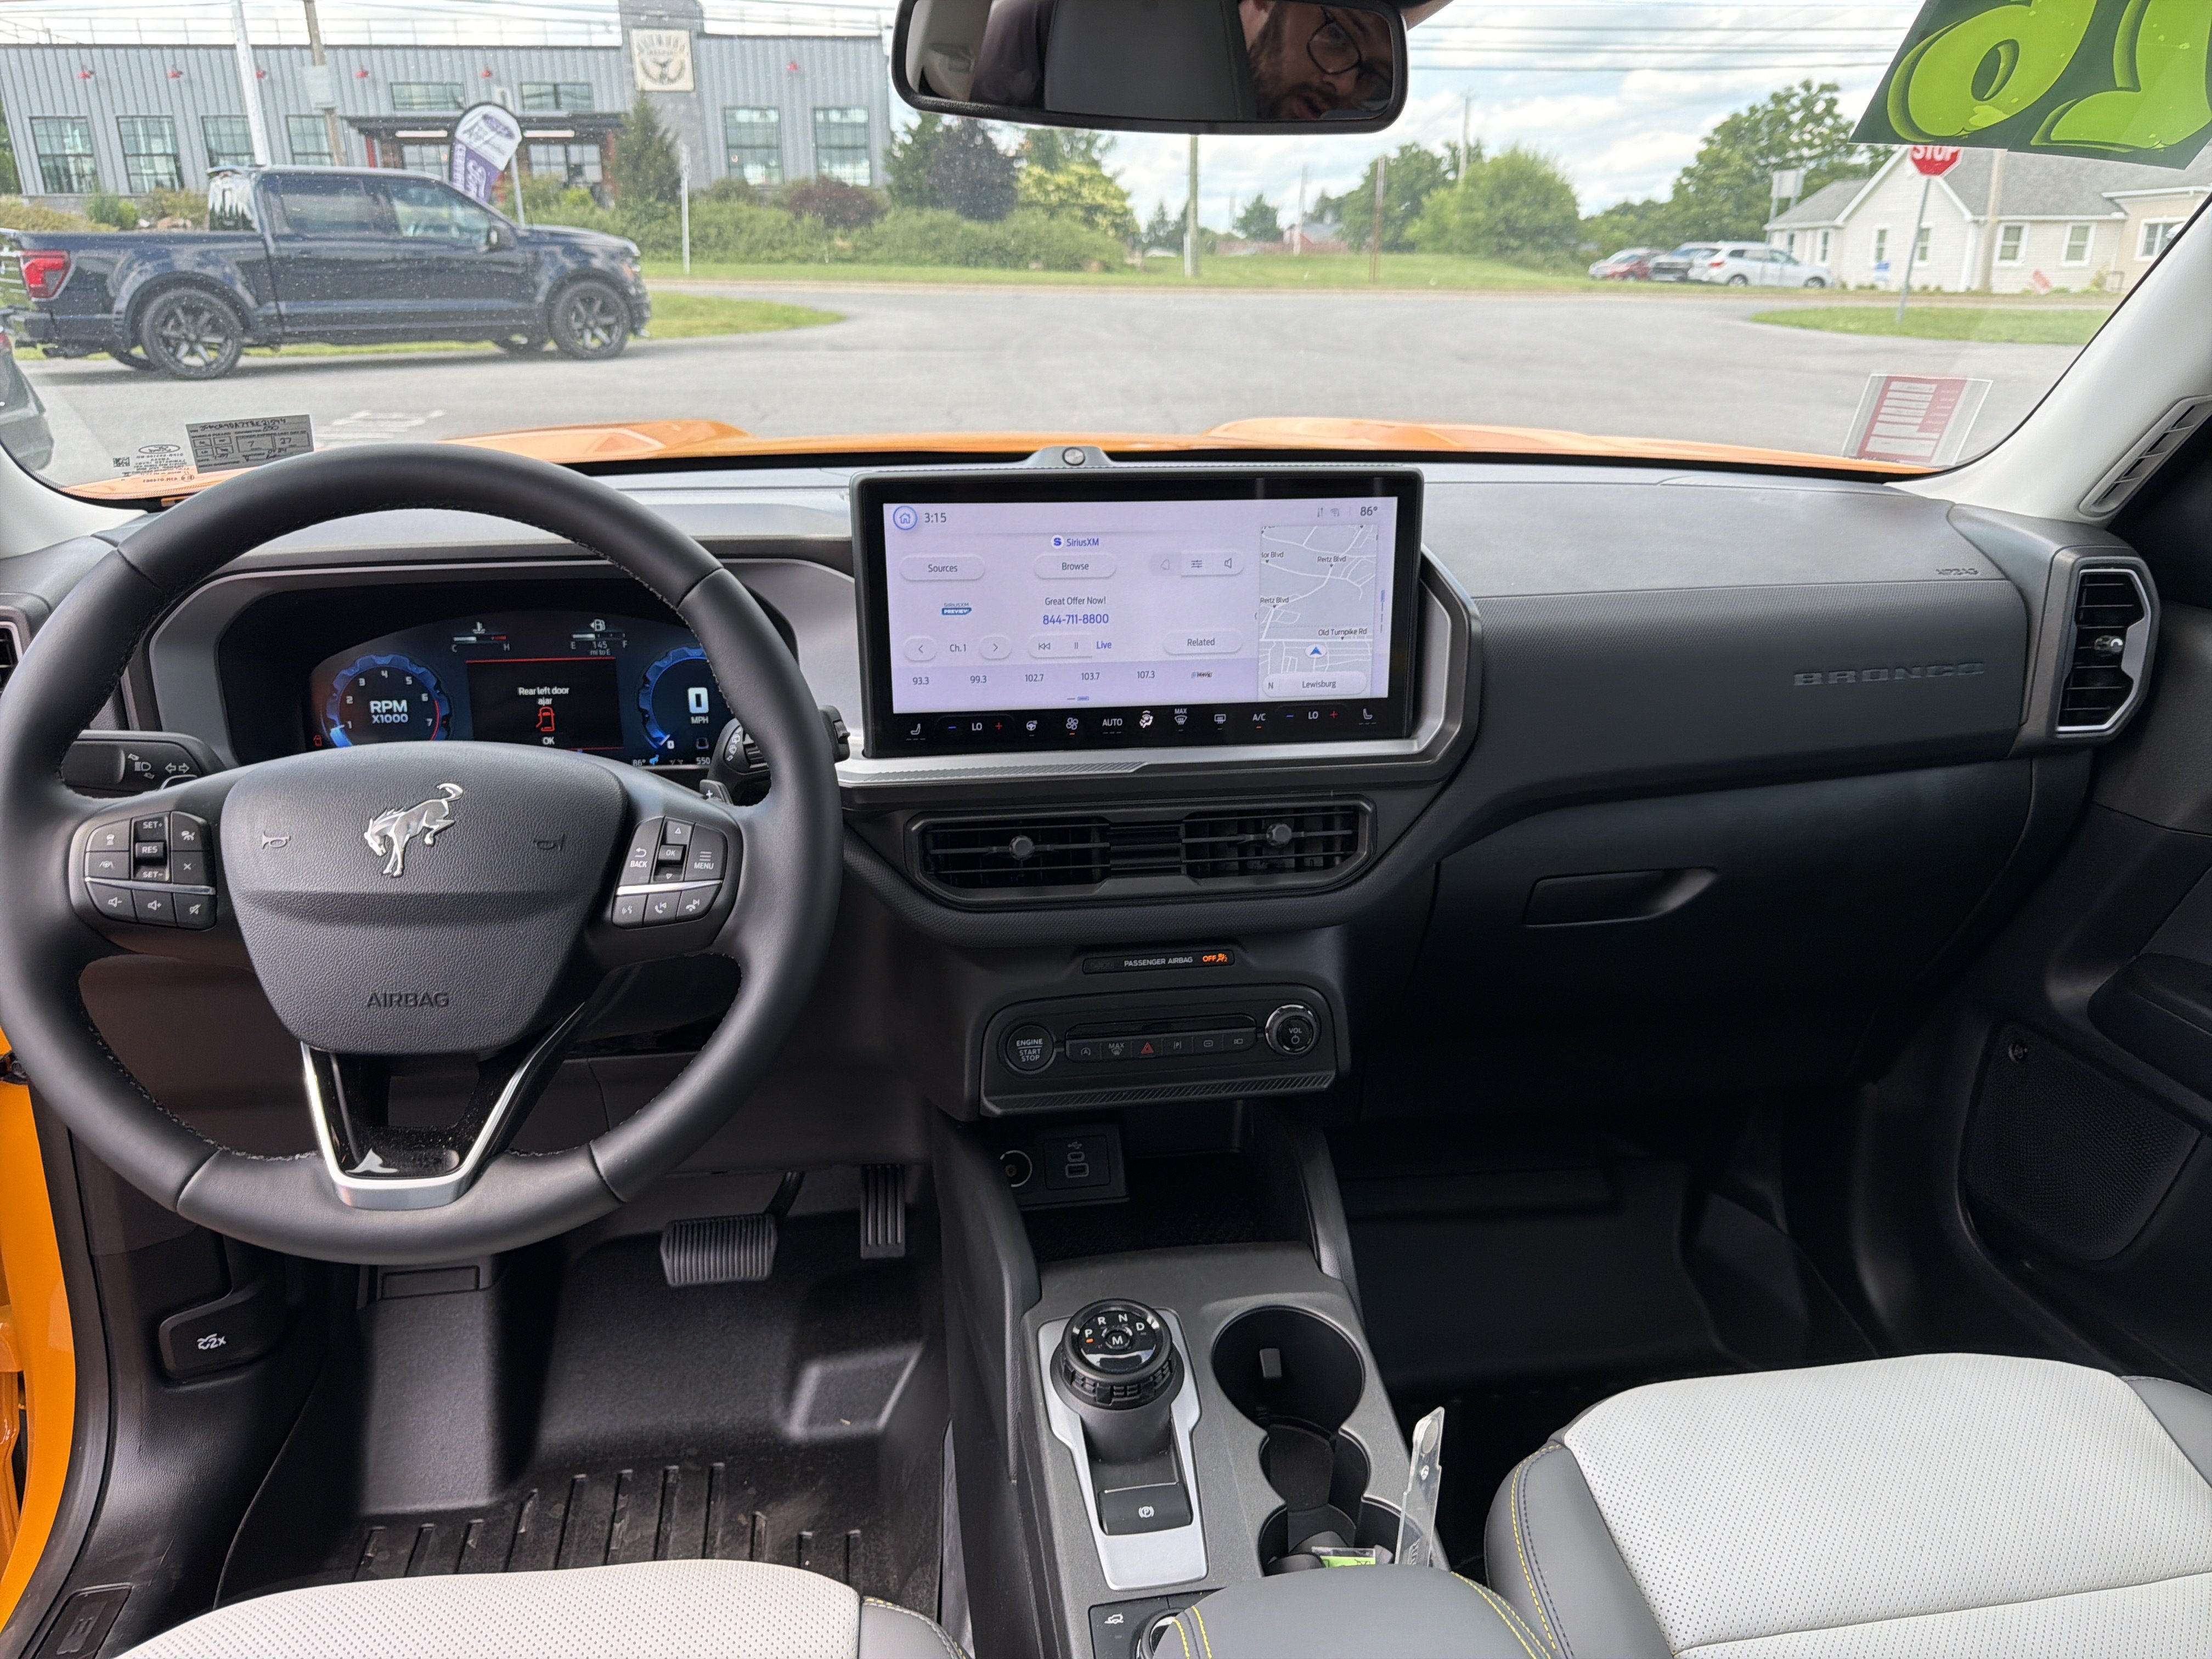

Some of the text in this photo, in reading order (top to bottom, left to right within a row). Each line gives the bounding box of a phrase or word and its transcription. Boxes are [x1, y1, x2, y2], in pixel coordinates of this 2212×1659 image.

[1912, 146, 1959, 161] STOP
[1360, 506, 1378, 517] 86°
[924, 512, 947, 523] 3:15
[1066, 538, 1099, 547] SiriusXM
[928, 564, 958, 573] Sources
[1062, 562, 1089, 571] Browse
[1045, 596, 1106, 606] Great Offer Now!
[1042, 613, 1109, 625] 844-711-8800
[1331, 629, 1358, 637] Turnpike
[571, 641, 576, 650] E
[592, 641, 608, 649] 145
[623, 640, 628, 648] F
[1096, 640, 1113, 650] Live
[1187, 637, 1215, 647] Related
[451, 644, 458, 653] C
[503, 643, 510, 652] H
[949, 644, 967, 652] Ch. 1
[381, 670, 388, 679] 4
[1025, 674, 1044, 682] 102.7
[1081, 672, 1100, 681] 103.7
[1137, 670, 1155, 680] 107.3
[1793, 662, 1984, 686] BRONCO
[359, 678, 366, 686] 3
[405, 676, 413, 685] 5
[913, 676, 929, 685] 93.3
[970, 675, 987, 684] 99.3
[1302, 680, 1336, 689] Lewisburg
[518, 686, 569, 696] Rear left door
[346, 696, 353, 704] 2
[421, 693, 428, 702] 6
[538, 697, 552, 706] ajar
[687, 687, 709, 714] 0
[369, 699, 408, 714] RPM
[372, 714, 409, 724] X1000
[1252, 713, 1266, 721] A/C
[1308, 712, 1319, 720] LO
[347, 720, 353, 729] 1
[426, 718, 433, 726] 7
[1102, 718, 1123, 727] AUTO
[972, 723, 983, 731] LO
[543, 737, 555, 745] OK
[696, 757, 711, 765] 550
[142, 846, 158, 854] RES
[630, 860, 648, 868] BACK
[693, 862, 714, 870] MENU
[1124, 958, 1166, 967] PASSENGER
[1167, 957, 1193, 965] AIRBAG
[1202, 955, 1217, 963] OFF
[366, 991, 449, 1008] AIRBAG
[1016, 1038, 1043, 1047] ENGINE
[1019, 1048, 1042, 1057] START
[1097, 1313, 1128, 1325] R N
[1136, 1322, 1146, 1331] D
[1084, 1329, 1093, 1339] P
[1111, 1335, 1124, 1346] M
